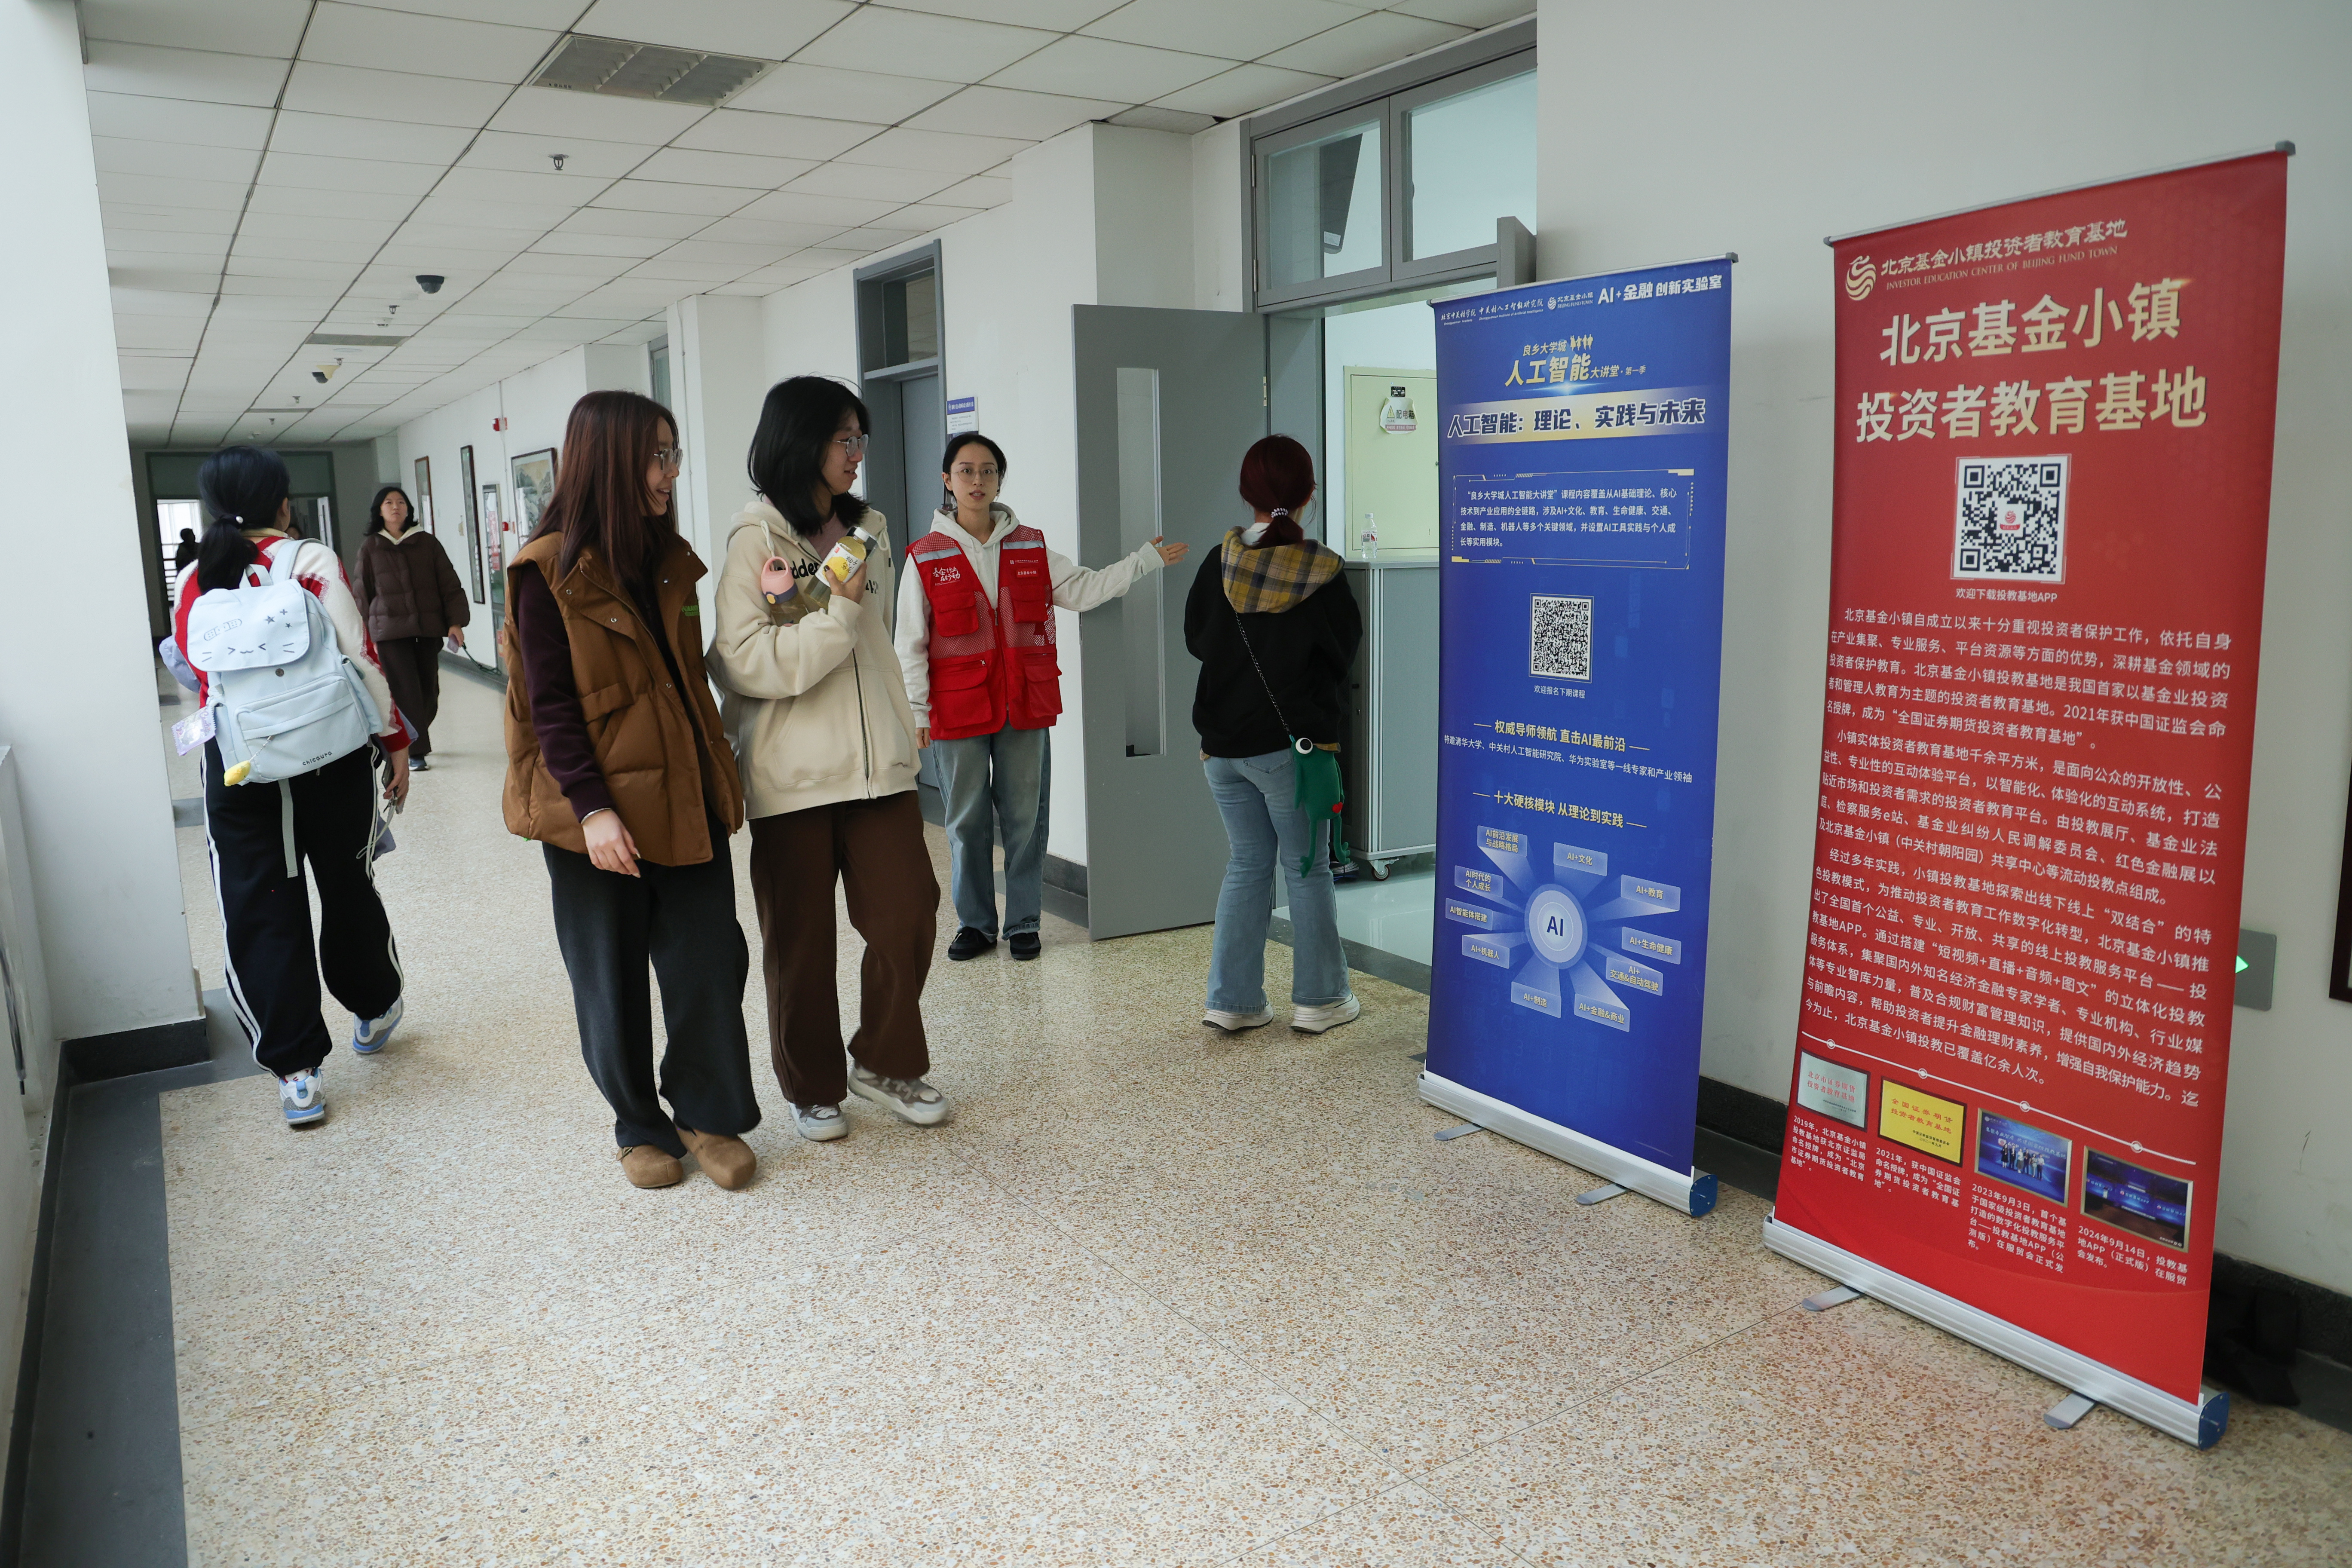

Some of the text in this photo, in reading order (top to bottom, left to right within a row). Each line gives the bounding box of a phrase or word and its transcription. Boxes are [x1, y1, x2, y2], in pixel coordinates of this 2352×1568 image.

[1881, 218, 2128, 276] 北京基金小镇投资者教育基地
[1886, 246, 2118, 290] INVESTOR EDUCATION CENTER OF BEIJING FUND TOWN
[1656, 274, 1723, 294] 创新实验室
[1557, 292, 1593, 302] 北京基金小镇
[1479, 298, 1544, 315] 中关村人工智能研究院
[1441, 309, 1476, 321] 北京中关村学院
[1879, 278, 2181, 366] 北京基金小镇
[1523, 340, 1567, 357] 良乡大学城
[1504, 353, 1591, 387] 人工智能
[1856, 366, 2208, 443] 投资者教育基地
[1396, 409, 1415, 419] 配电箱
[1461, 537, 1503, 547] 长等实用模块。
[1956, 588, 2058, 602] 欢迎下载投教基地APP
[1534, 685, 1585, 699] 欢迎报名下期课程
[1494, 720, 1626, 752] 权威导师领航 直击AI最前沿
[1494, 790, 1623, 828] 十大硬核模块 从理论到实践
[1486, 829, 1519, 843] AI前沿发展
[1486, 838, 1518, 853] 与战略格局
[1567, 852, 1592, 865] AI+文化
[1465, 870, 1491, 883] AI时代的
[1465, 879, 1491, 892] 个人成长
[1636, 885, 1664, 900] AI+教育
[1450, 906, 1487, 923] AI智能体搭建
[1547, 916, 1564, 937] AI
[1471, 944, 1500, 960] AI+机器人
[1629, 936, 1673, 956] AI+生命健康
[1628, 965, 1640, 975] AI+
[1610, 969, 1659, 992] 交通&自动驾驶
[1523, 993, 1547, 1008] AI+制造
[1579, 1002, 1625, 1024] AI+金融&商业
